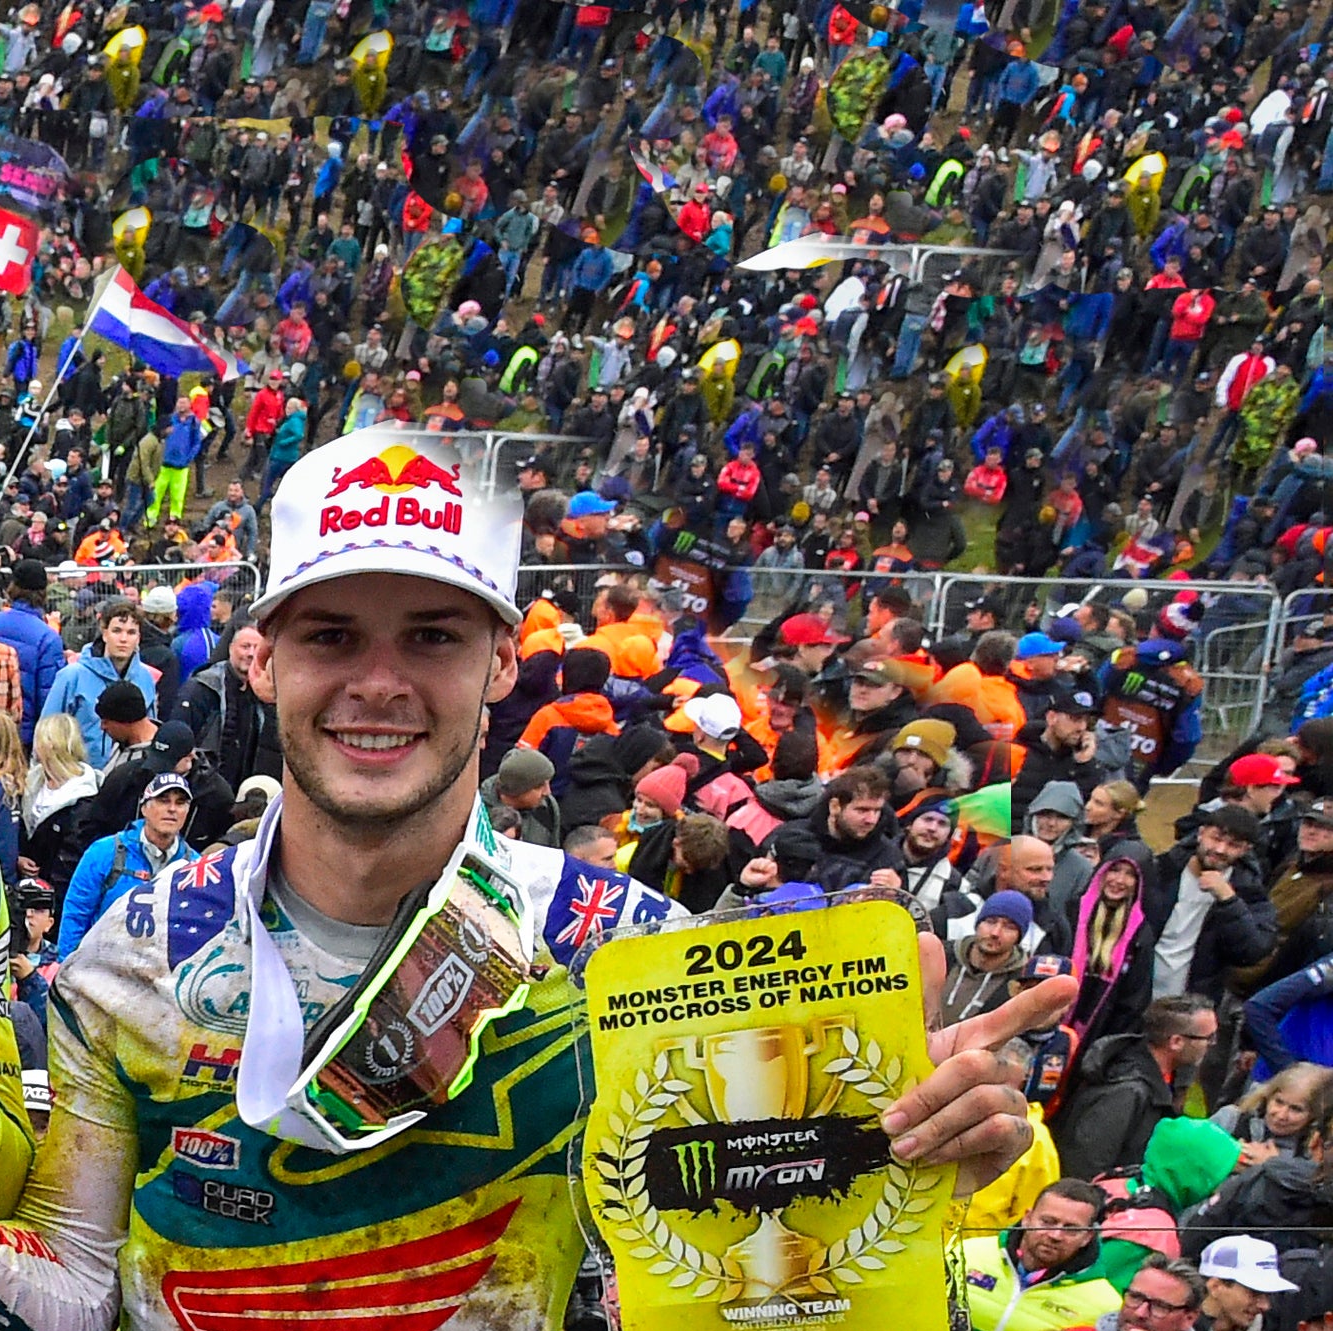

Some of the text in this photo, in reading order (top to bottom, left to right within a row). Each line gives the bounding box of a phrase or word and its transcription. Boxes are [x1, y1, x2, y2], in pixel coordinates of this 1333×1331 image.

[319, 495, 463, 537] Red Bull
[160, 773, 185, 785] USA
[685, 929, 808, 976] 2024
[422, 960, 466, 1022] 100%
[607, 957, 886, 1012] MONSTER ENERGY FIM
[599, 974, 910, 1032] MOTOCROSS OF NATIONS
[179, 1136, 231, 1163] 100%
[727, 1129, 820, 1151] MONSTER
[724, 1158, 827, 1191] MXON
[204, 1180, 274, 1210] QUAD
[203, 1199, 273, 1225] LOCK
[723, 1299, 851, 1321] WINNING TEAM
